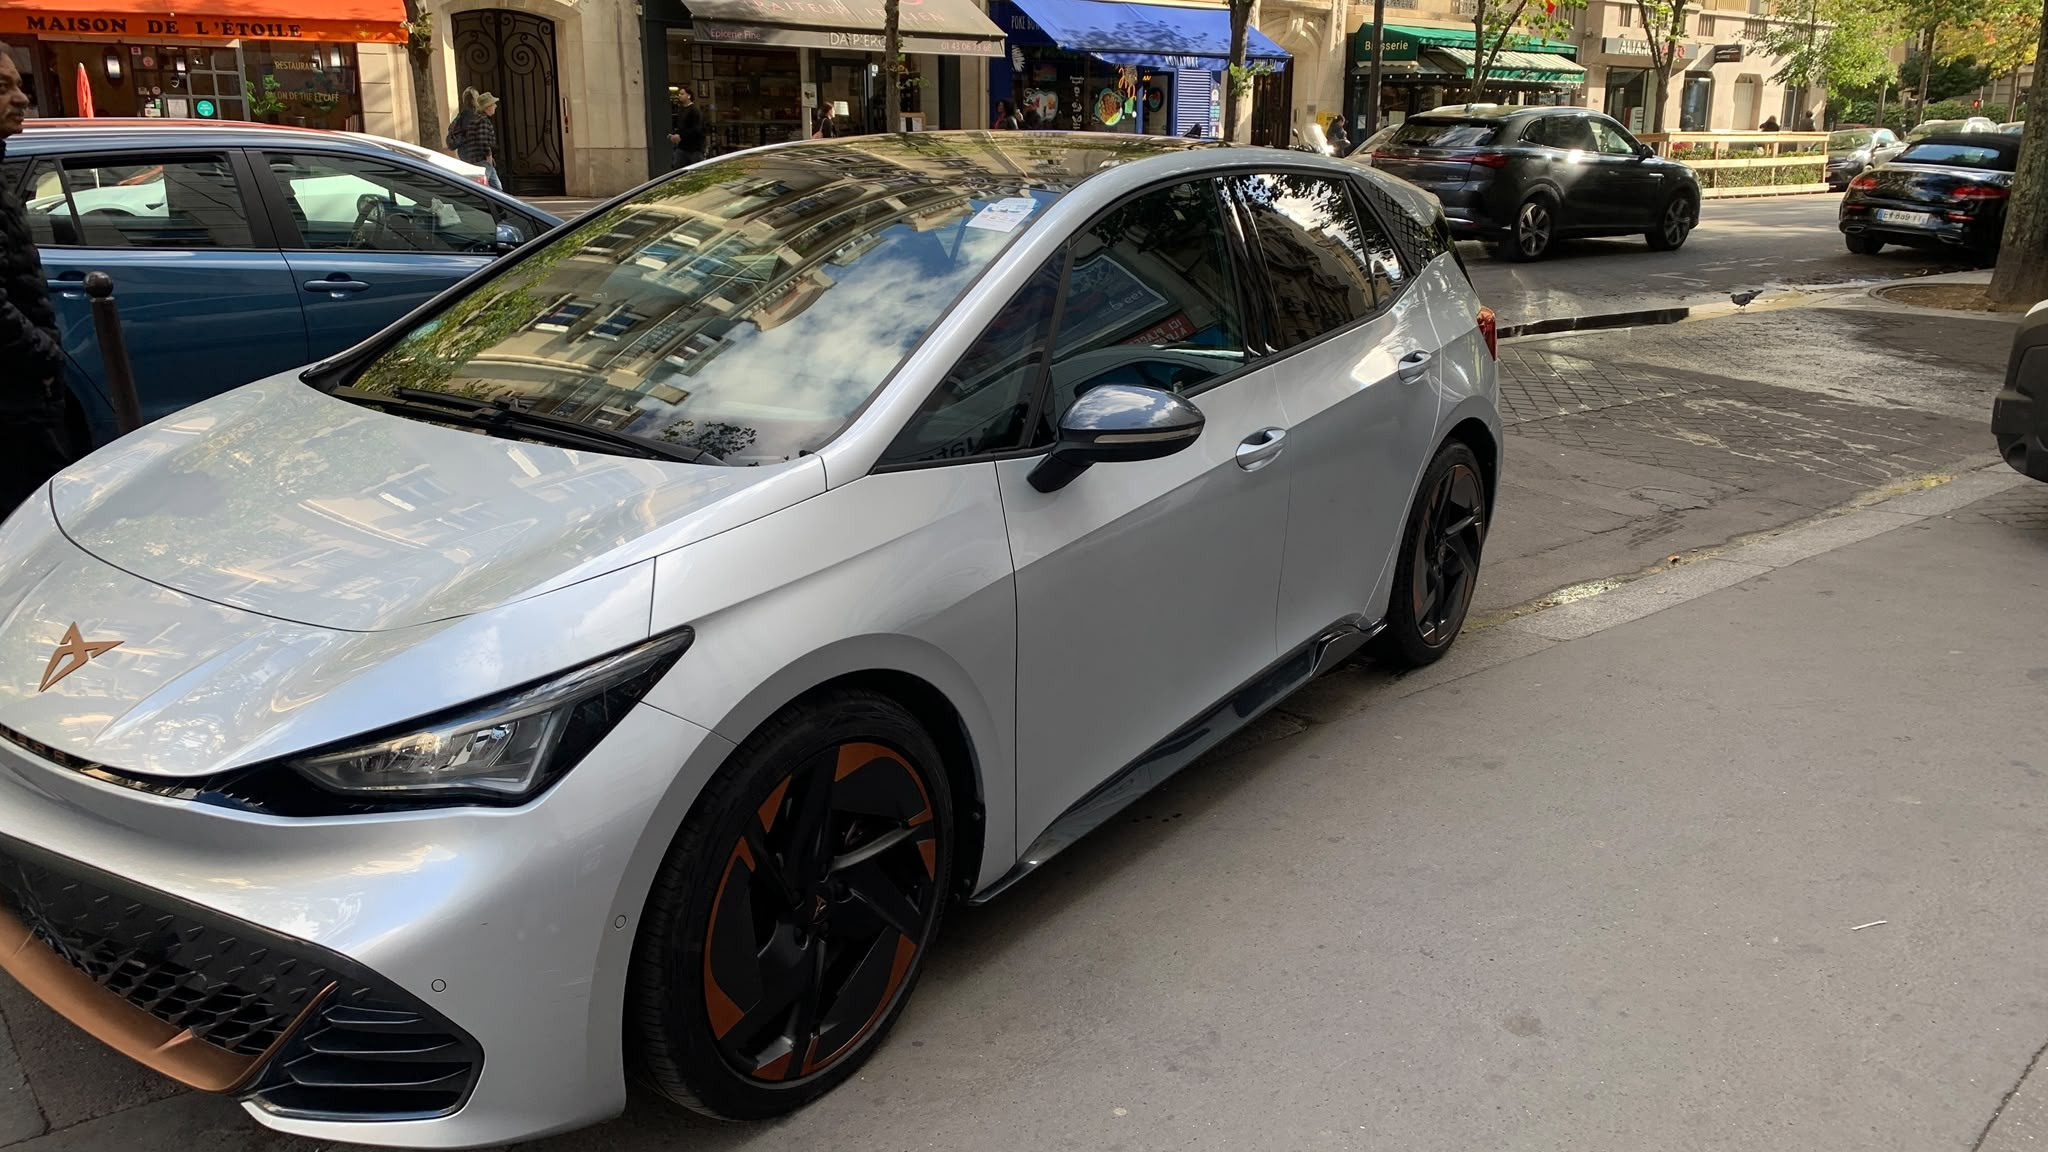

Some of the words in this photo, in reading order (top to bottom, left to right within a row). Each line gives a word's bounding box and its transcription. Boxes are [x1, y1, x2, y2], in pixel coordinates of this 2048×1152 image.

[864, 7, 945, 22] ITLIEN
[26, 16, 127, 33] MAISON
[147, 20, 179, 34] DE
[1364, 40, 1409, 51] Bsserie
[274, 60, 315, 71] RESTAURA
